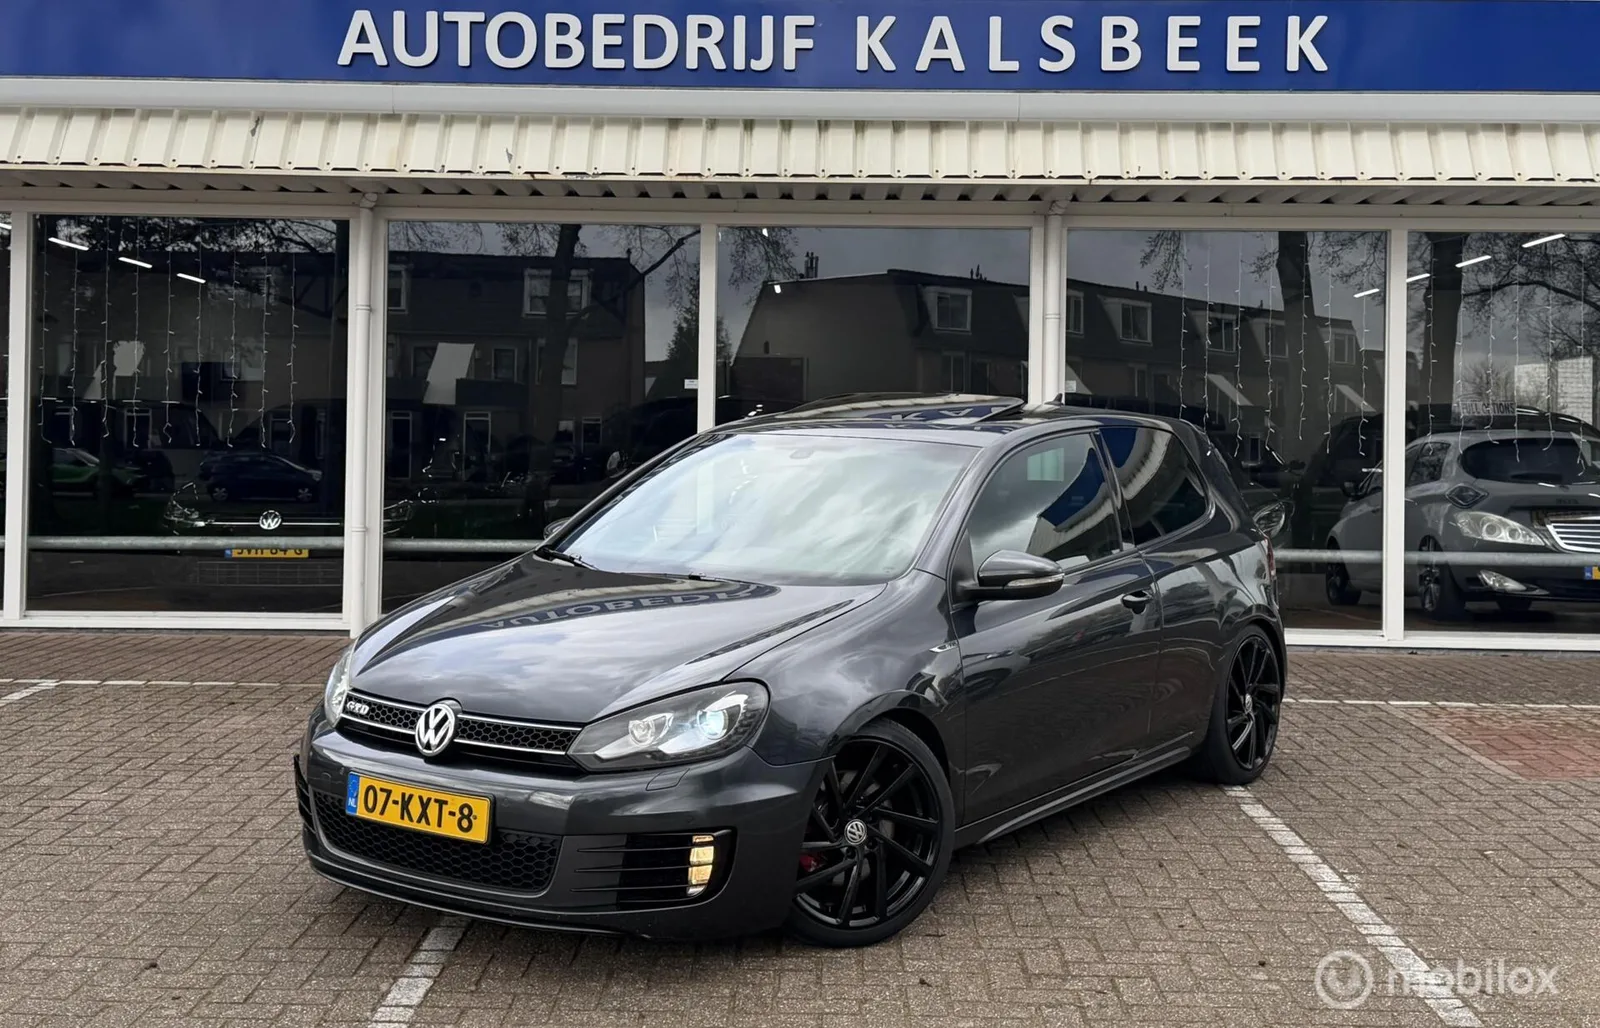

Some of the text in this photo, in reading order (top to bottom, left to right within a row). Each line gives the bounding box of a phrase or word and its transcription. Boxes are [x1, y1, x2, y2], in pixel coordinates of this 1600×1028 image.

[337, 9, 1328, 73] AUTOBEDRIJF KALSBEEK
[346, 701, 370, 715] GTD
[363, 784, 473, 833] 07-KXT-8
